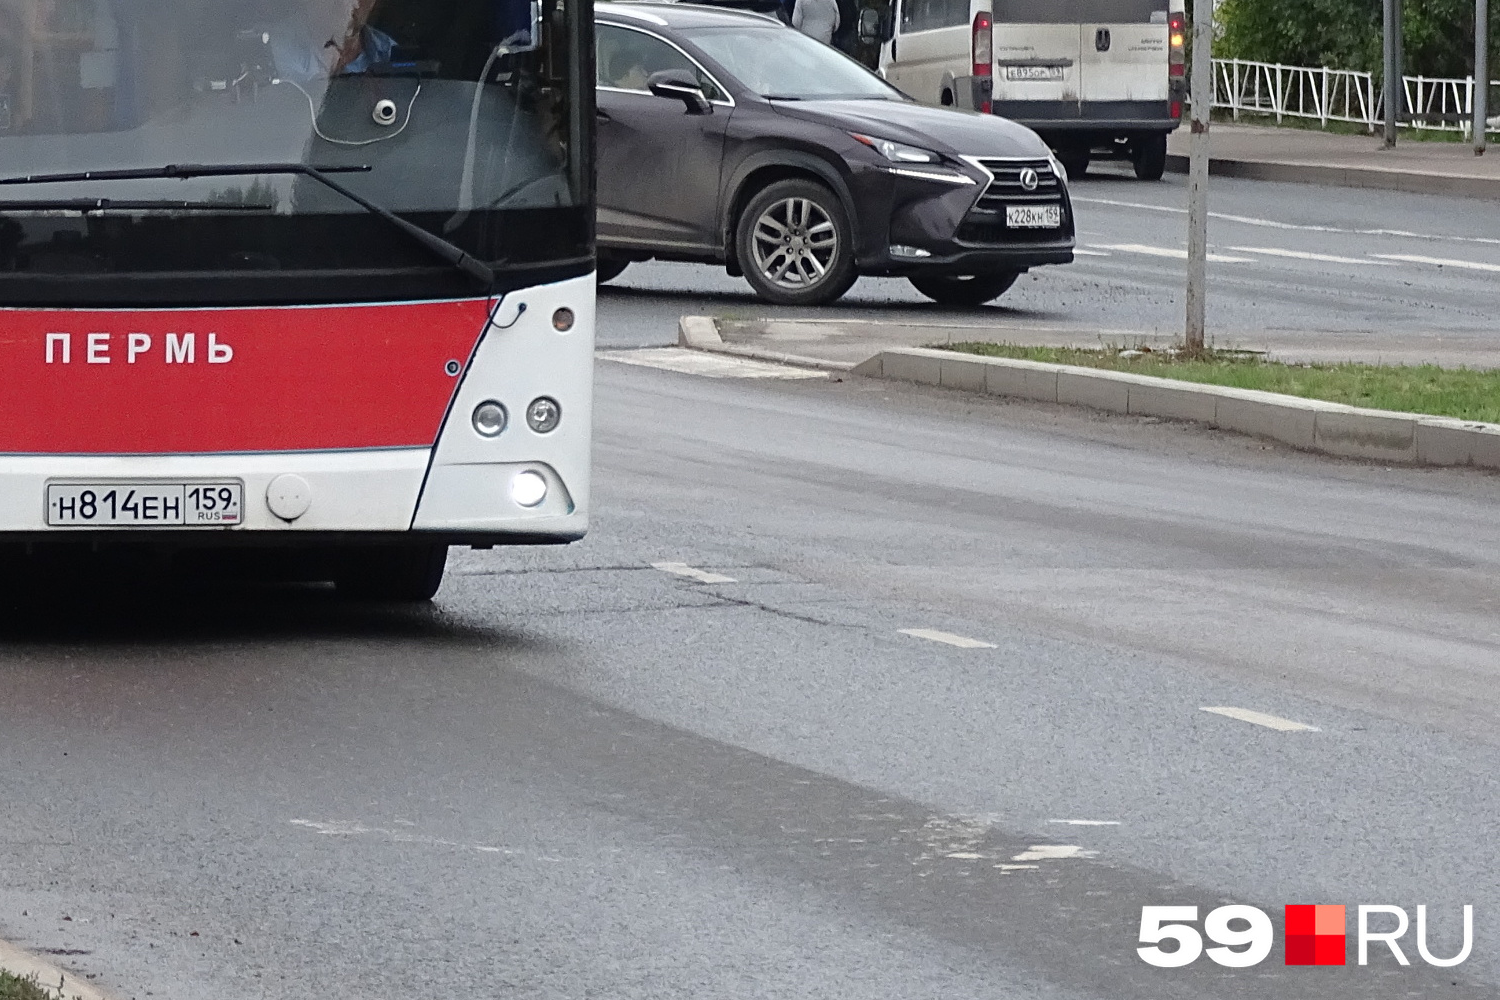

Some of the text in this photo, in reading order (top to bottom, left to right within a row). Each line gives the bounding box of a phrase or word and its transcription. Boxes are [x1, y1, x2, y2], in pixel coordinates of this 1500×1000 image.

[45, 332, 234, 364] ПЕРМЬ
[59, 487, 233, 520] Н814ЕН 159
[198, 511, 221, 521] RUS
